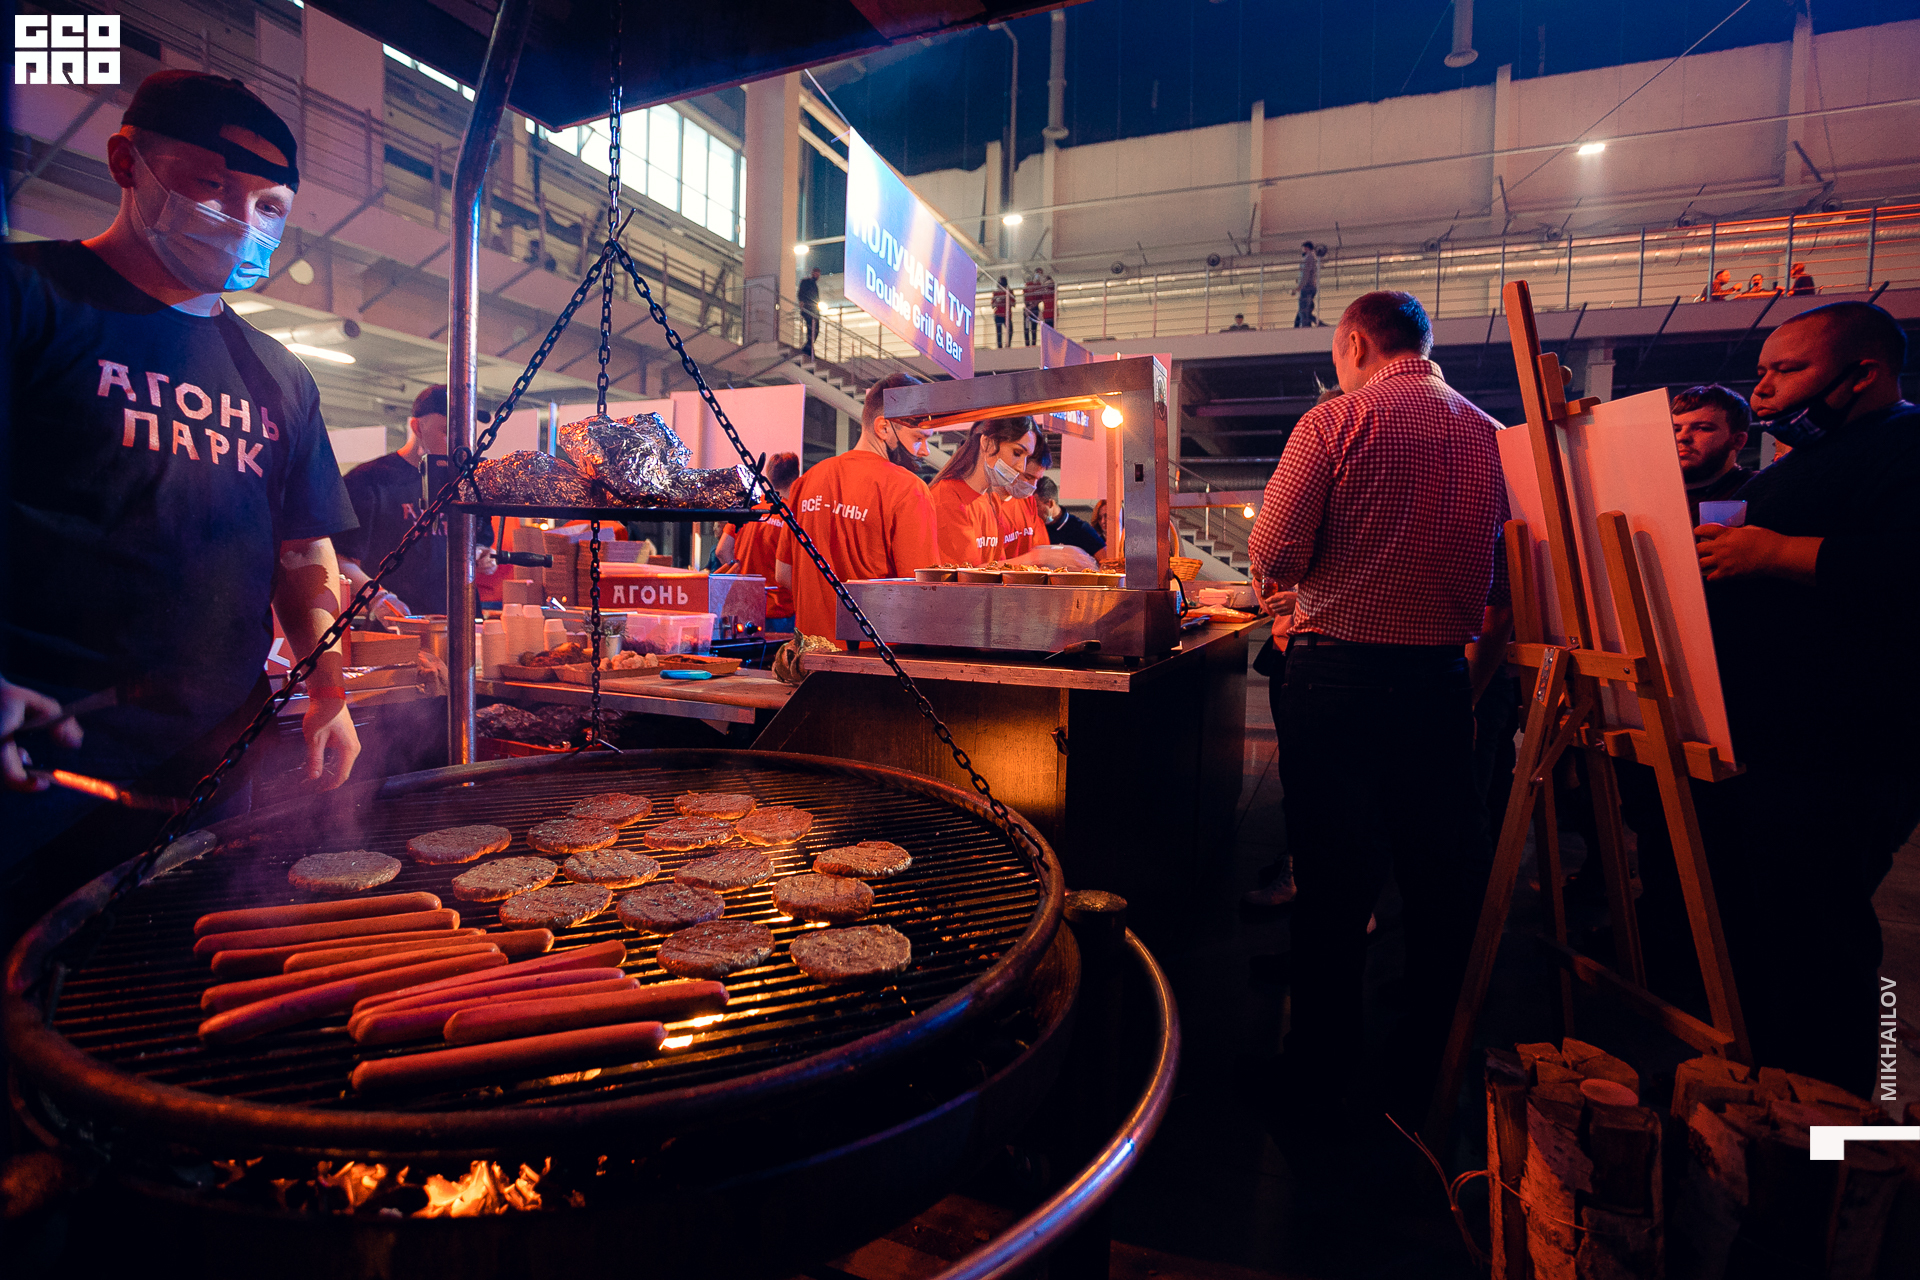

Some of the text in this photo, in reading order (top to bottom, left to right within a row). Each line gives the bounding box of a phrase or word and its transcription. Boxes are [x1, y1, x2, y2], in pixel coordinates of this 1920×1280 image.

[866, 263, 963, 363] Double Grill & Bar
[947, 290, 972, 335] ТУТ
[97, 359, 280, 442] АГОНЬ
[122, 407, 264, 478] ПАРК
[801, 495, 823, 513] ВСЁ
[612, 585, 689, 605] АГОНЬ
